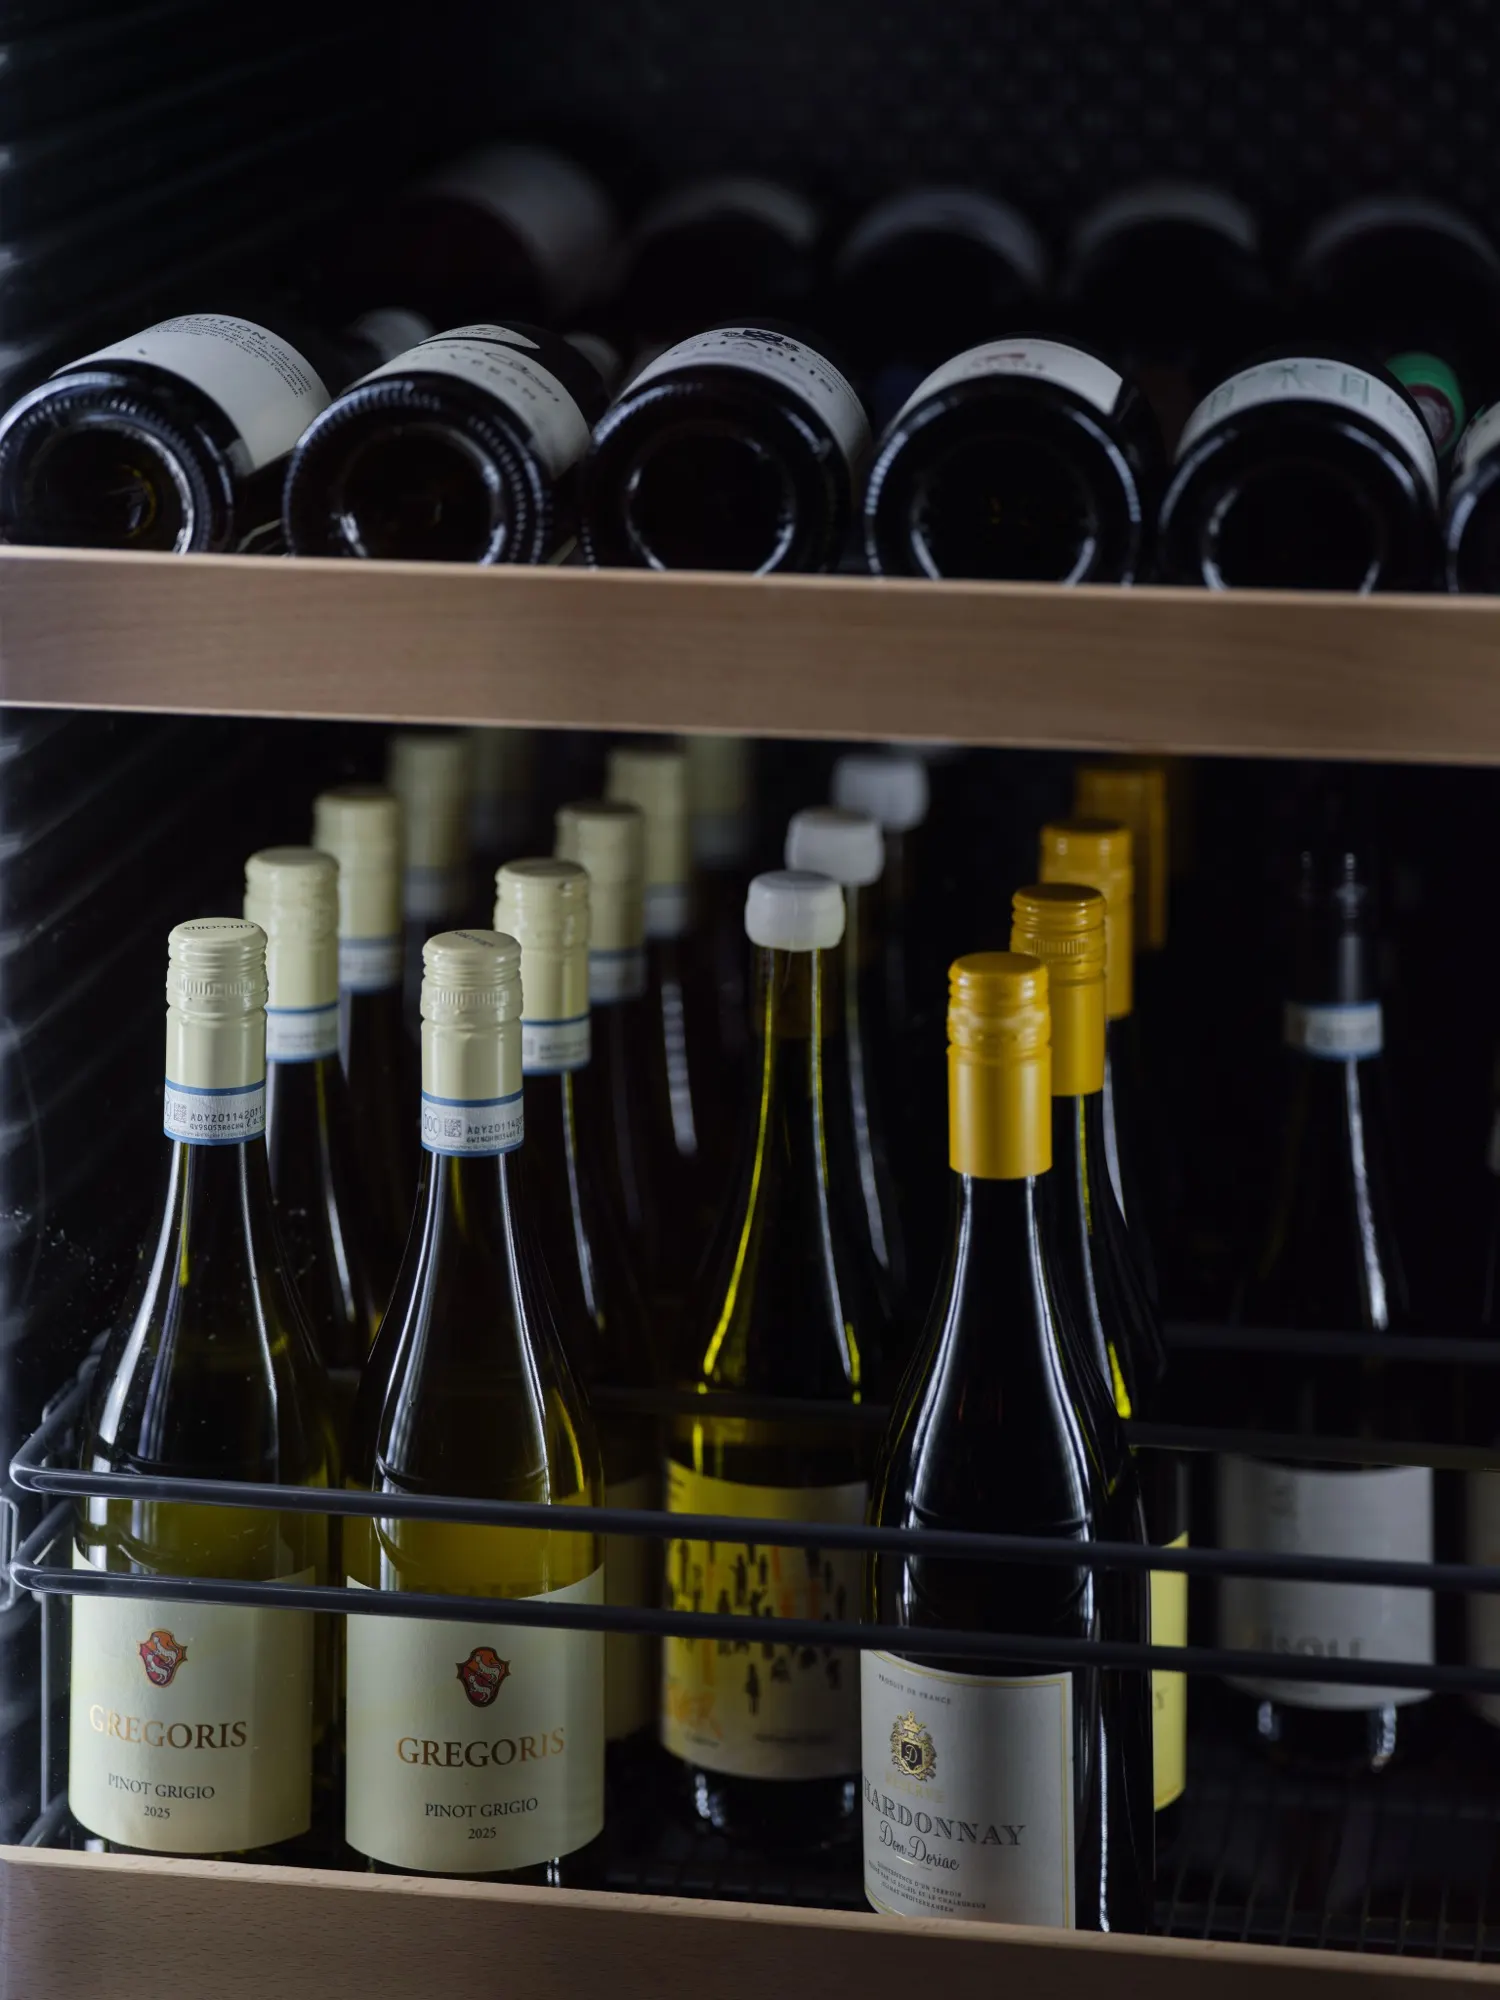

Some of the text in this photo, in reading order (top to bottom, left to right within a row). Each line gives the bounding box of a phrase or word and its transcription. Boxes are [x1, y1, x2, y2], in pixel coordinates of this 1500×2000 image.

[918, 1691, 951, 1705] FRANCE
[89, 1703, 247, 1749] GREGORIS
[397, 1727, 565, 1767] GREGORIS
[108, 1772, 216, 1800] PINOT GRIGIO
[144, 1805, 171, 1819] 2025
[424, 1797, 539, 1818] PINOT GRIGIO
[863, 1775, 1027, 1846] HARDONNAY
[468, 1827, 497, 1839] 2025
[907, 1835, 961, 1872] Doriac
